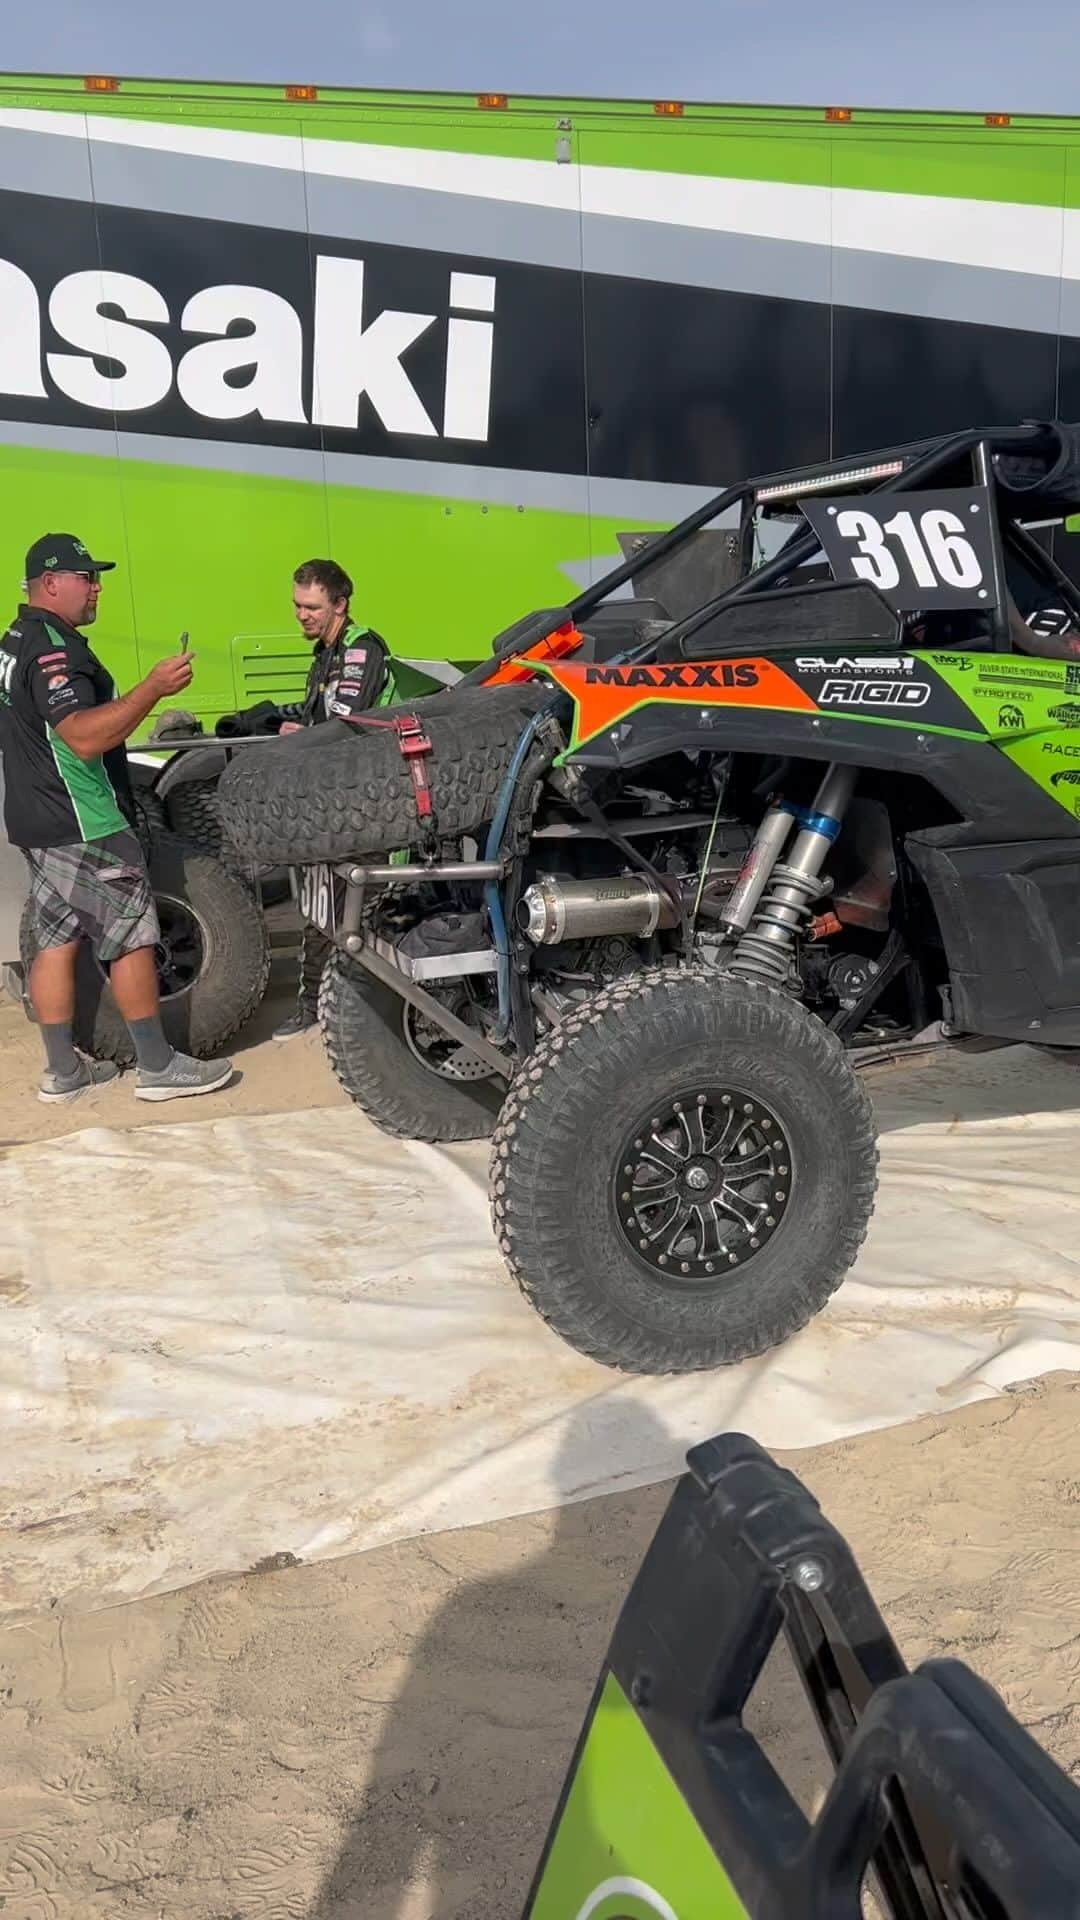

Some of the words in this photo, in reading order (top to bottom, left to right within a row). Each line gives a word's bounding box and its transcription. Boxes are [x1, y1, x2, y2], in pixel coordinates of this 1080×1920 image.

[836, 509, 983, 590] 316
[585, 664, 759, 687] MAXXIS
[798, 668, 914, 676] MOTORSPORTS
[818, 680, 931, 706] RIGID
